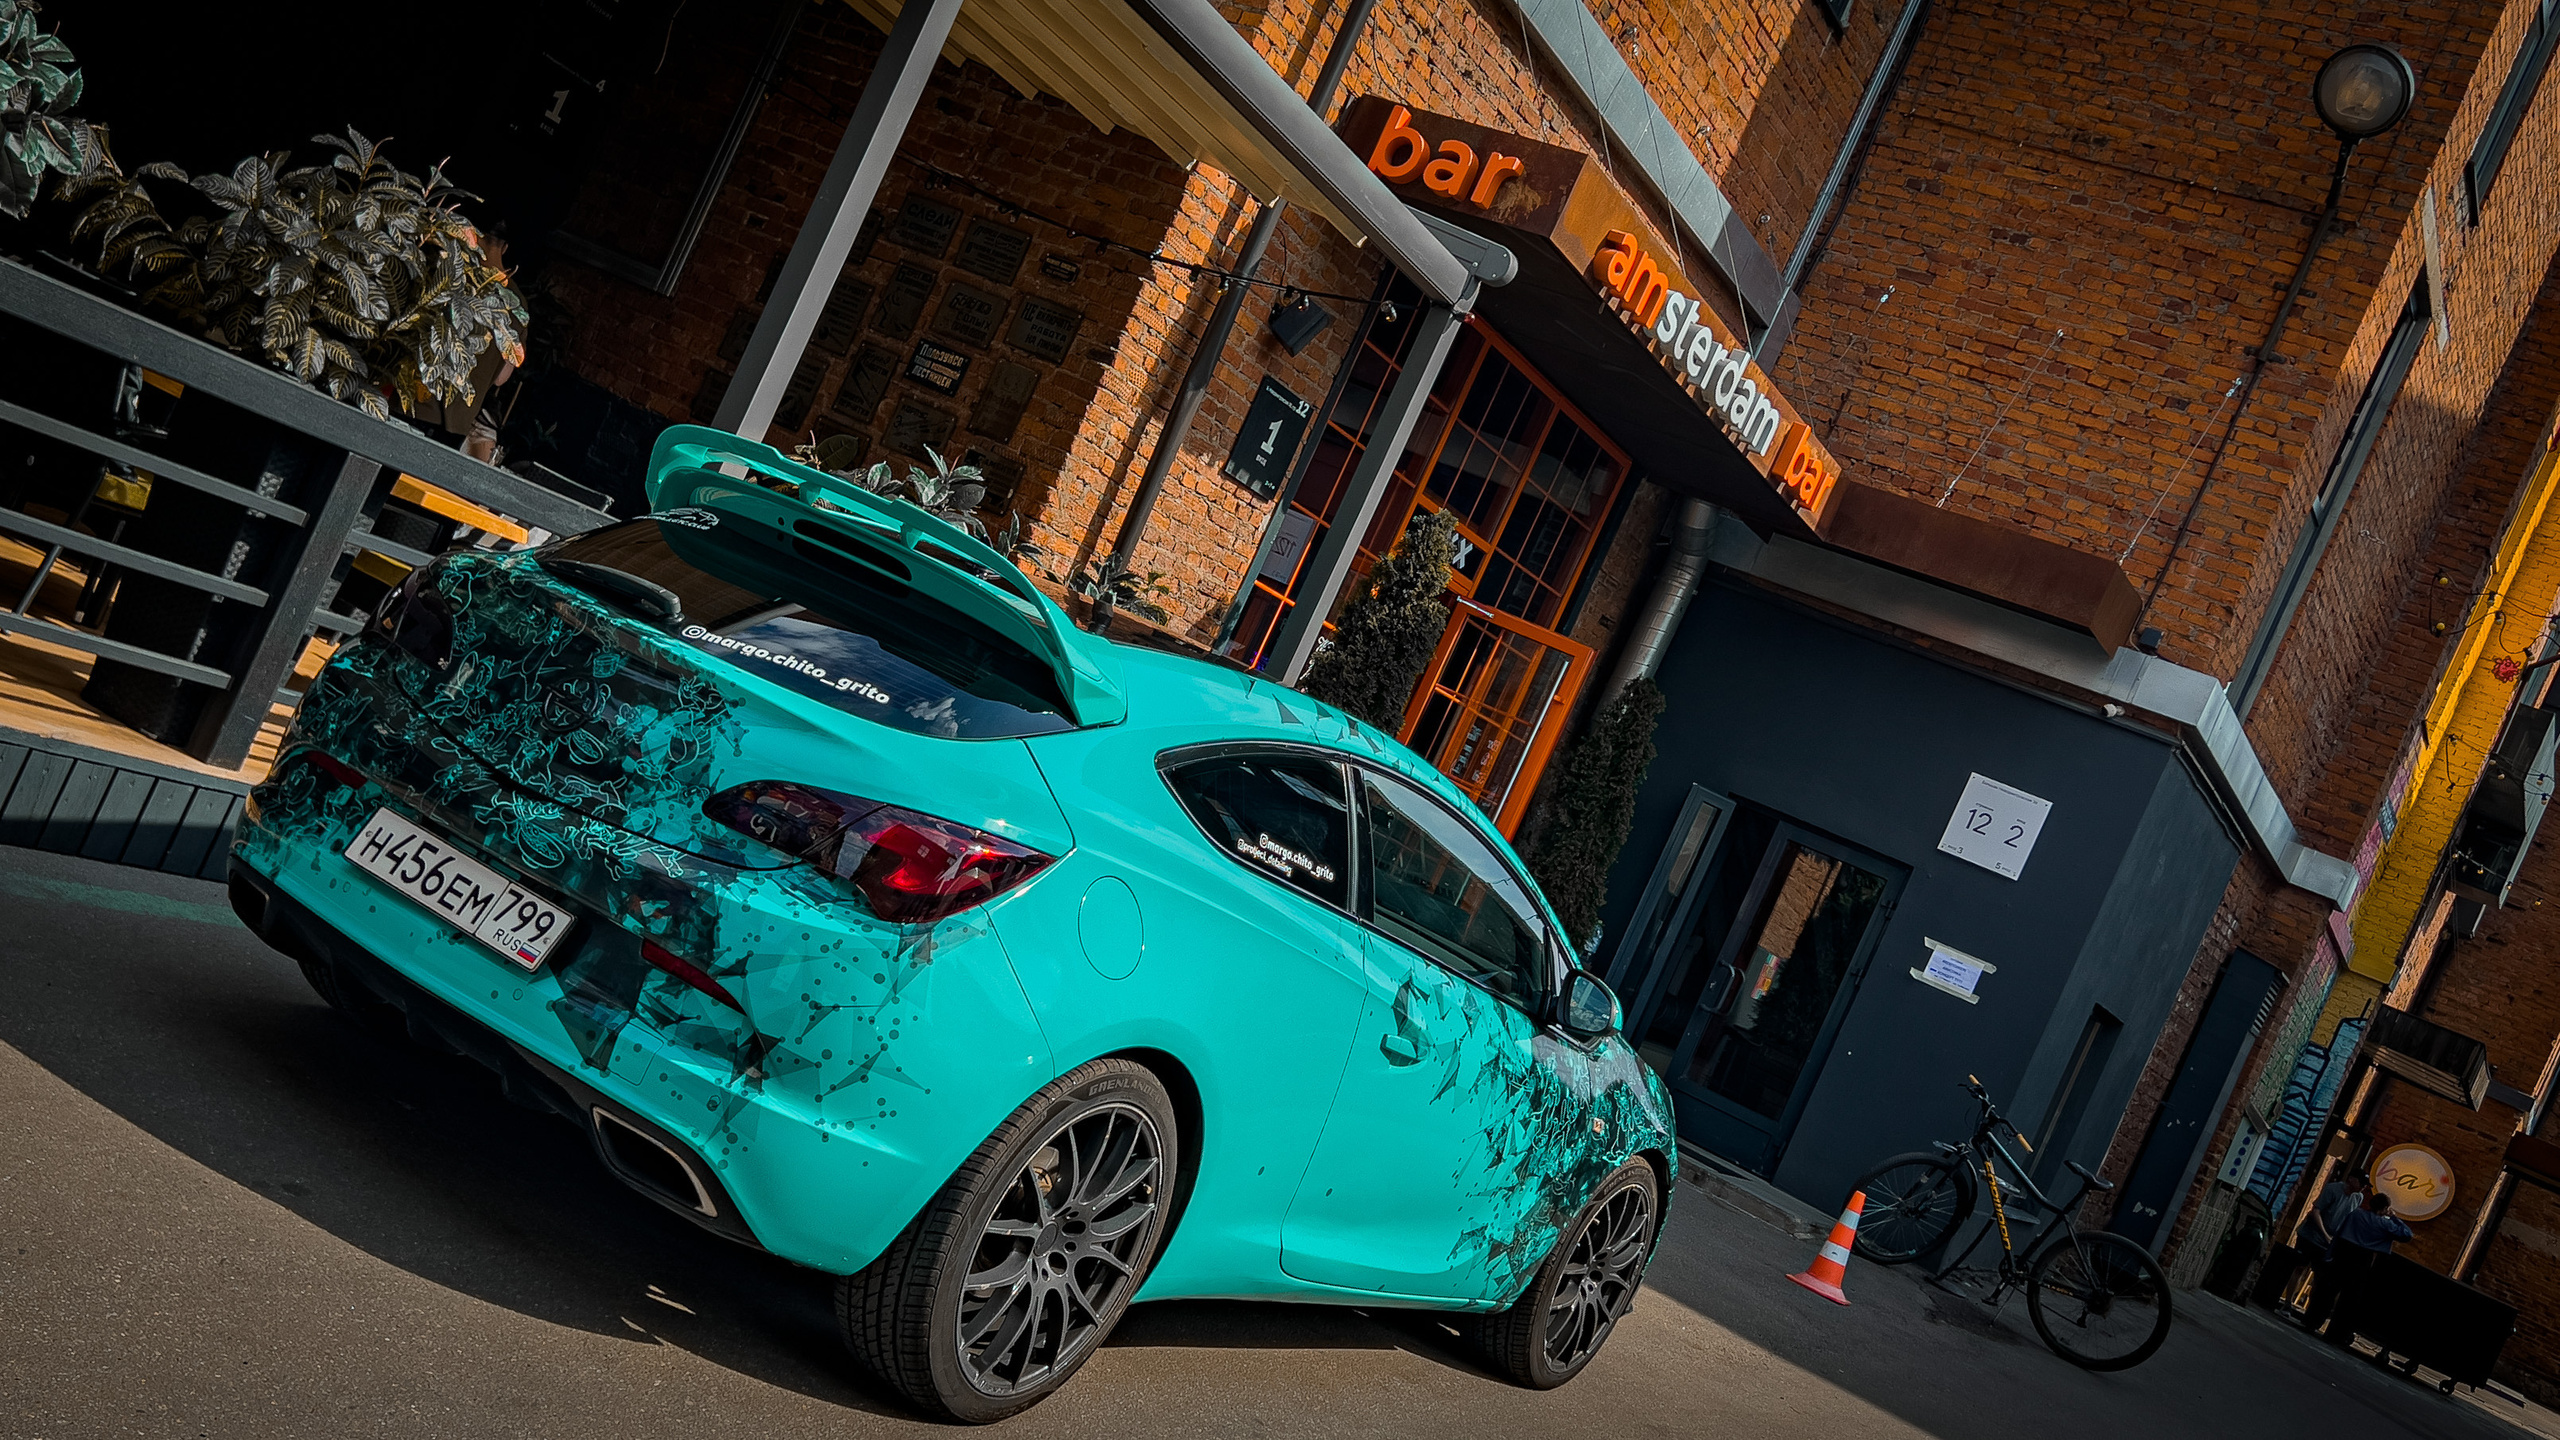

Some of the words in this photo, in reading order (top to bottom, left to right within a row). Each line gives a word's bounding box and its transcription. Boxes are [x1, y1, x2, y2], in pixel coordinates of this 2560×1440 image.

[545, 89, 570, 124] 1
[1368, 104, 1525, 210] bar
[1593, 229, 1780, 457] amsterdam
[1772, 421, 1834, 513] bar
[1295, 400, 1310, 419] 12
[1260, 419, 1284, 455] 1
[1965, 808, 1993, 836] 12
[1956, 846, 1964, 854] 3
[2003, 824, 2025, 849] 2
[1994, 862, 2002, 870] 5
[493, 888, 556, 943] 799
[493, 929, 522, 952] RUS
